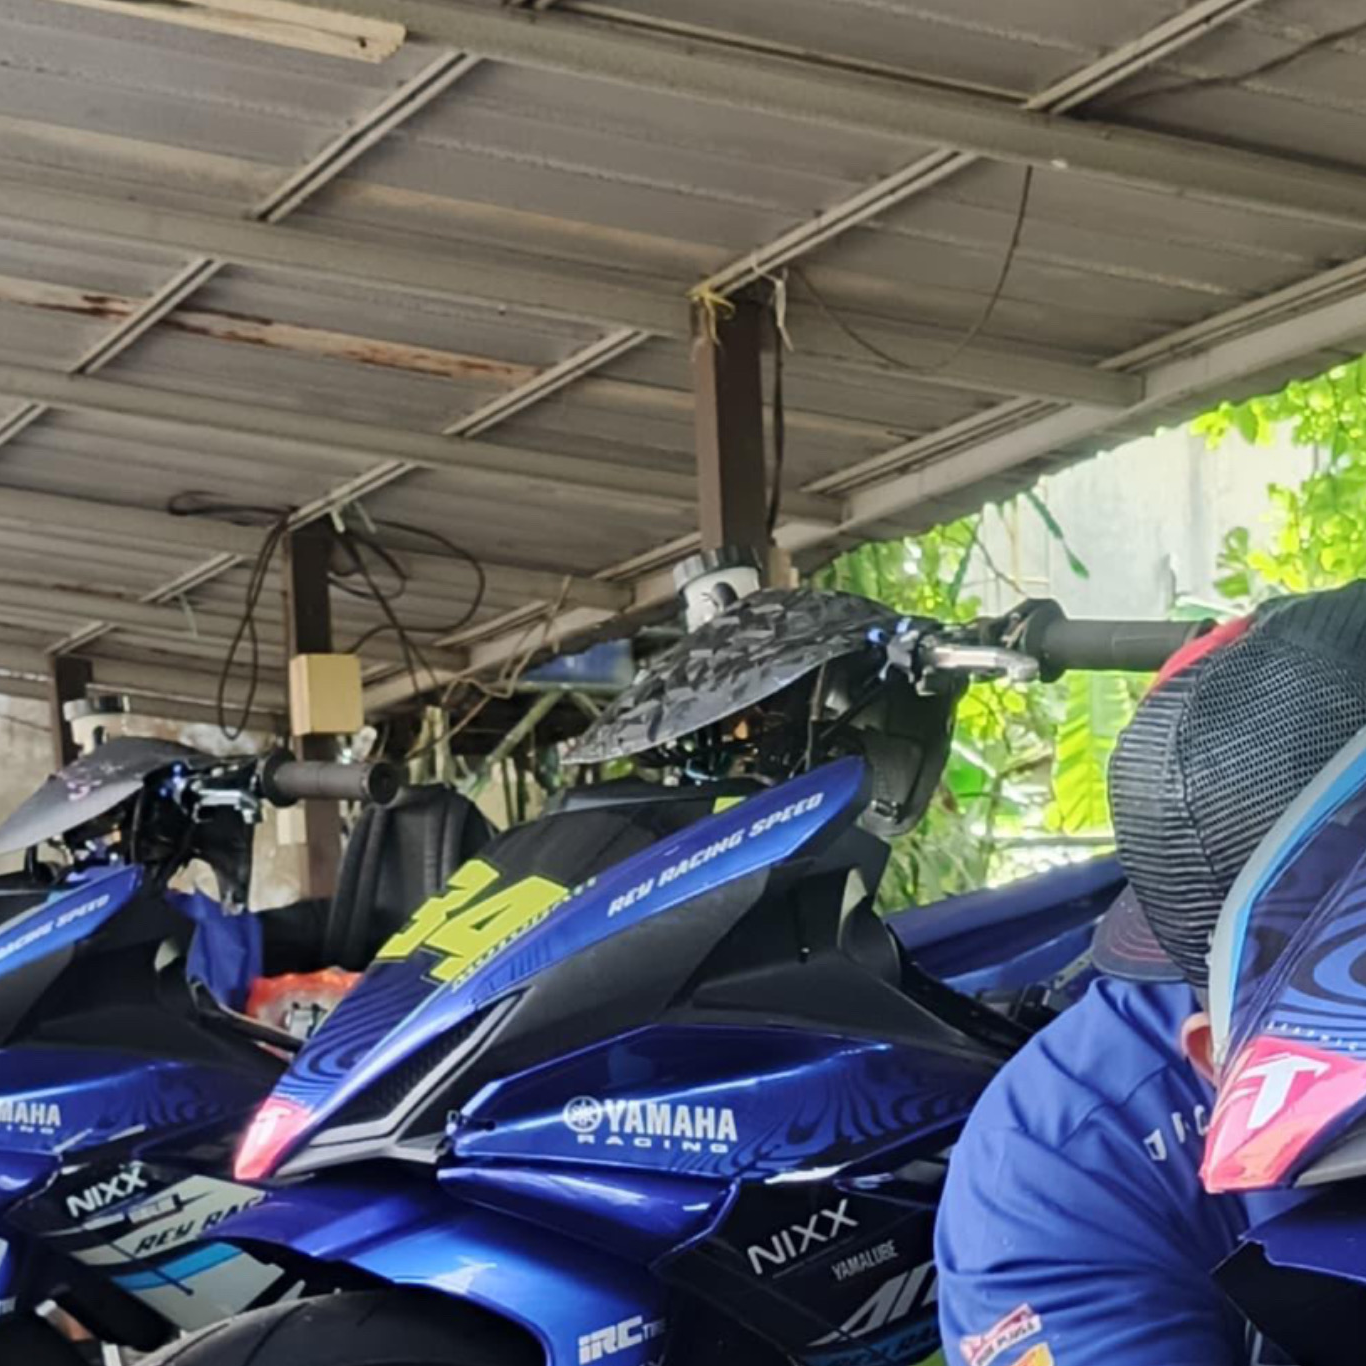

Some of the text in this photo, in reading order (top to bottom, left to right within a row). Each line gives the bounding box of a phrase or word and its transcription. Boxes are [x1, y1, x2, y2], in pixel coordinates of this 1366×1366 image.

[607, 792, 824, 917] REY RACING SPEED
[576, 1134, 729, 1153] RACING
[604, 1098, 738, 1142] YAMAHA
[66, 1163, 148, 1218] NIXX
[747, 1199, 859, 1275] NIXX
[831, 1239, 899, 1282] YAMALUBE
